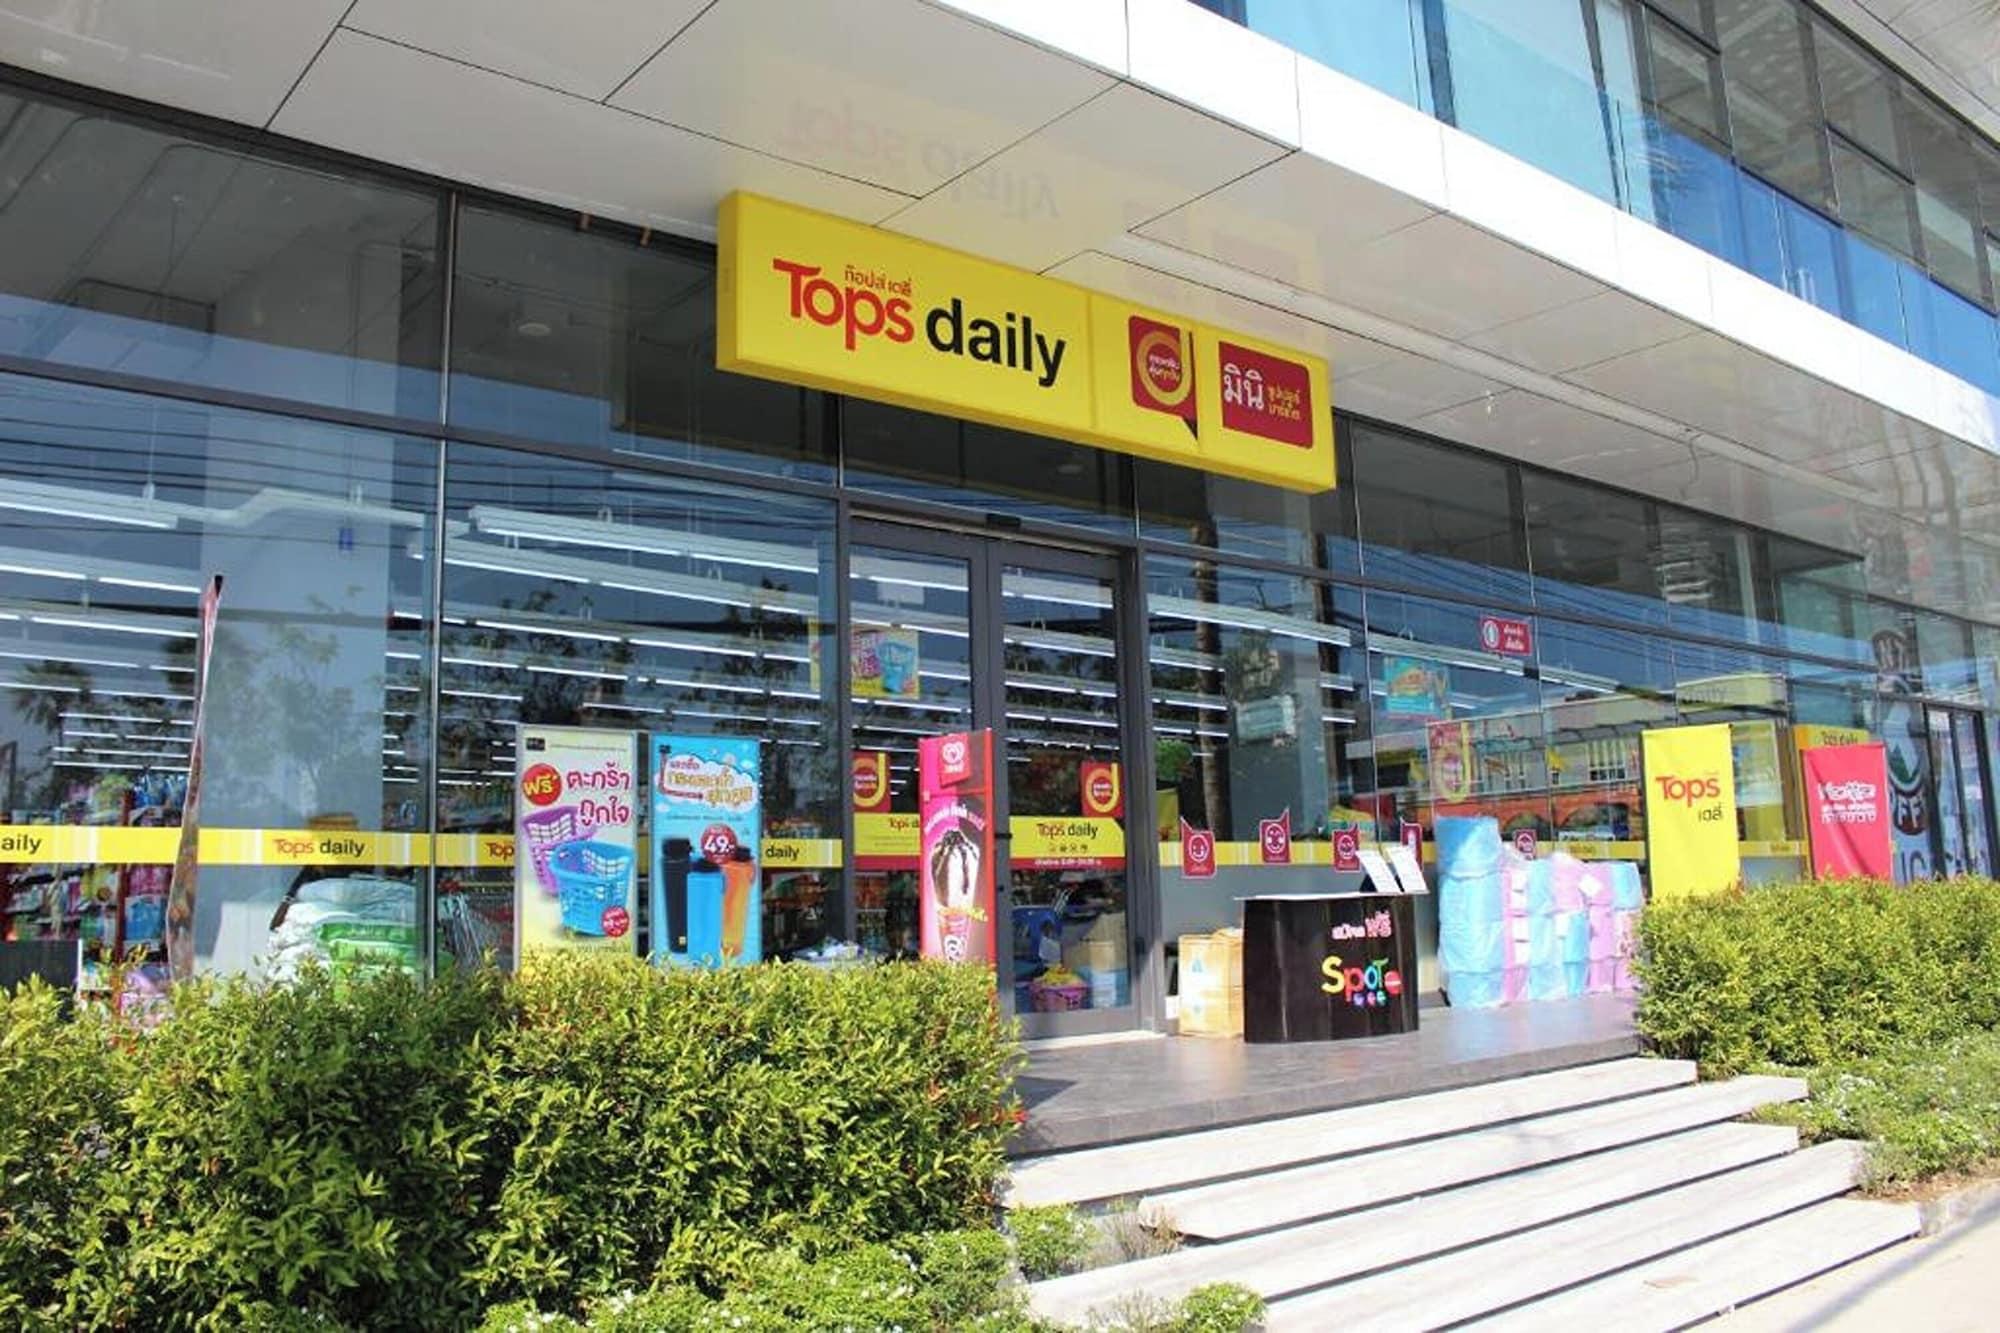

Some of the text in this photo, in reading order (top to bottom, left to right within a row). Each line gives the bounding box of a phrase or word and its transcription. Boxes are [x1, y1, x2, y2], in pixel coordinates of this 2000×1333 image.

[772, 257, 1067, 387] Tops daily
[1223, 362, 1264, 411] มินิ
[523, 773, 559, 797] ฟรี
[566, 761, 631, 790] ตะกร้า
[1655, 775, 1721, 808] Tops
[580, 795, 630, 827] ถูกใจ
[1036, 821, 1098, 840] Tops daily
[1, 833, 42, 855] aily
[273, 838, 366, 858] Tops daily
[485, 842, 515, 862] Top
[765, 845, 800, 861] daily
